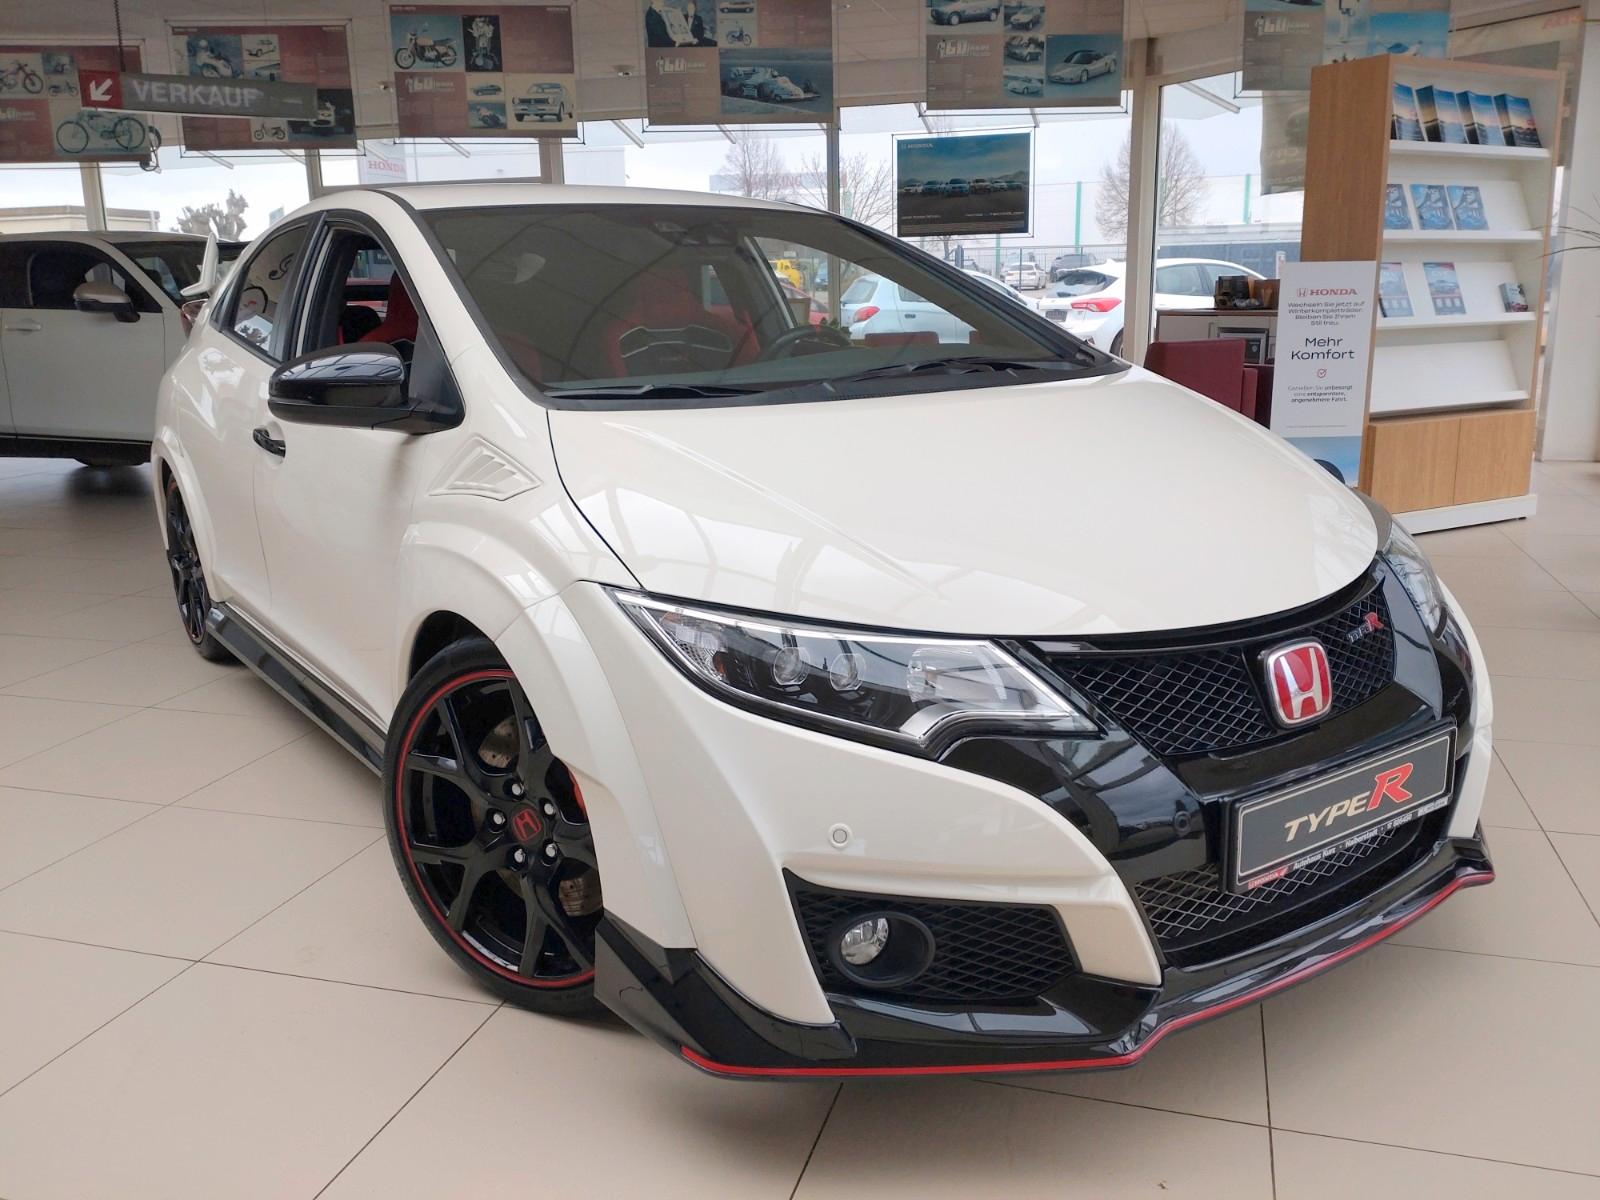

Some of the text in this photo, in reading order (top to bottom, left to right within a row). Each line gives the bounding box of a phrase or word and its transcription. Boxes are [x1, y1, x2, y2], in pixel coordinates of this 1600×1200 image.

[133, 79, 262, 107] VERKAUF
[1310, 288, 1358, 296] HONDA
[1305, 337, 1343, 347] Mehr
[1291, 349, 1355, 360] Komfort
[1293, 853, 1322, 870] Autohaus
[1322, 847, 1337, 859] Kurz
